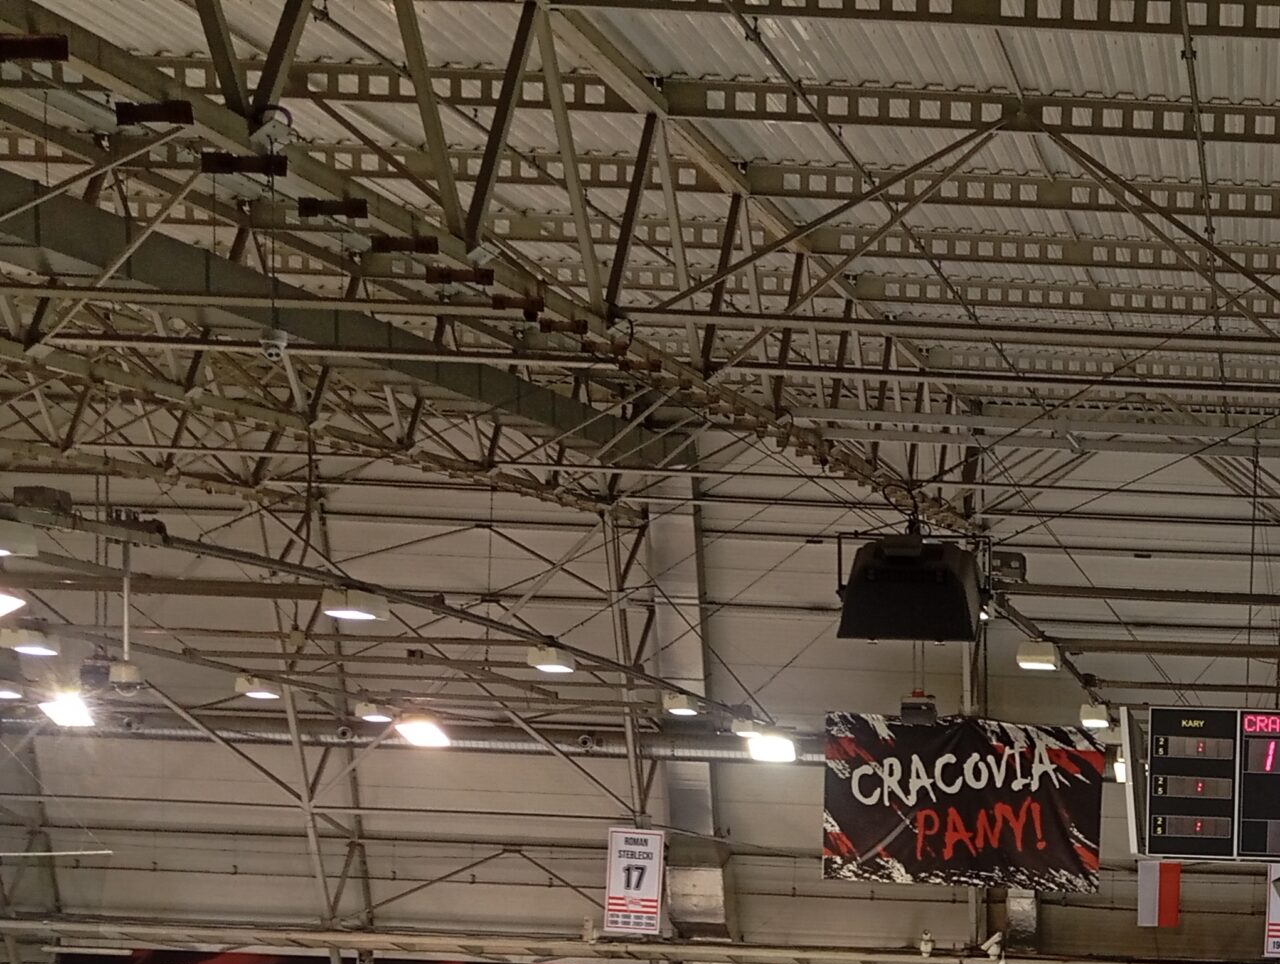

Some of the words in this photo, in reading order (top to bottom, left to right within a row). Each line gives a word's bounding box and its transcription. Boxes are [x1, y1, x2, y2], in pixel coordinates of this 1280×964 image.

[1181, 719, 1205, 728] KARY
[1264, 740, 1276, 772] 1
[851, 744, 1060, 806] CRACOVIA
[916, 797, 1047, 860] PANY!
[623, 864, 647, 891] 17
